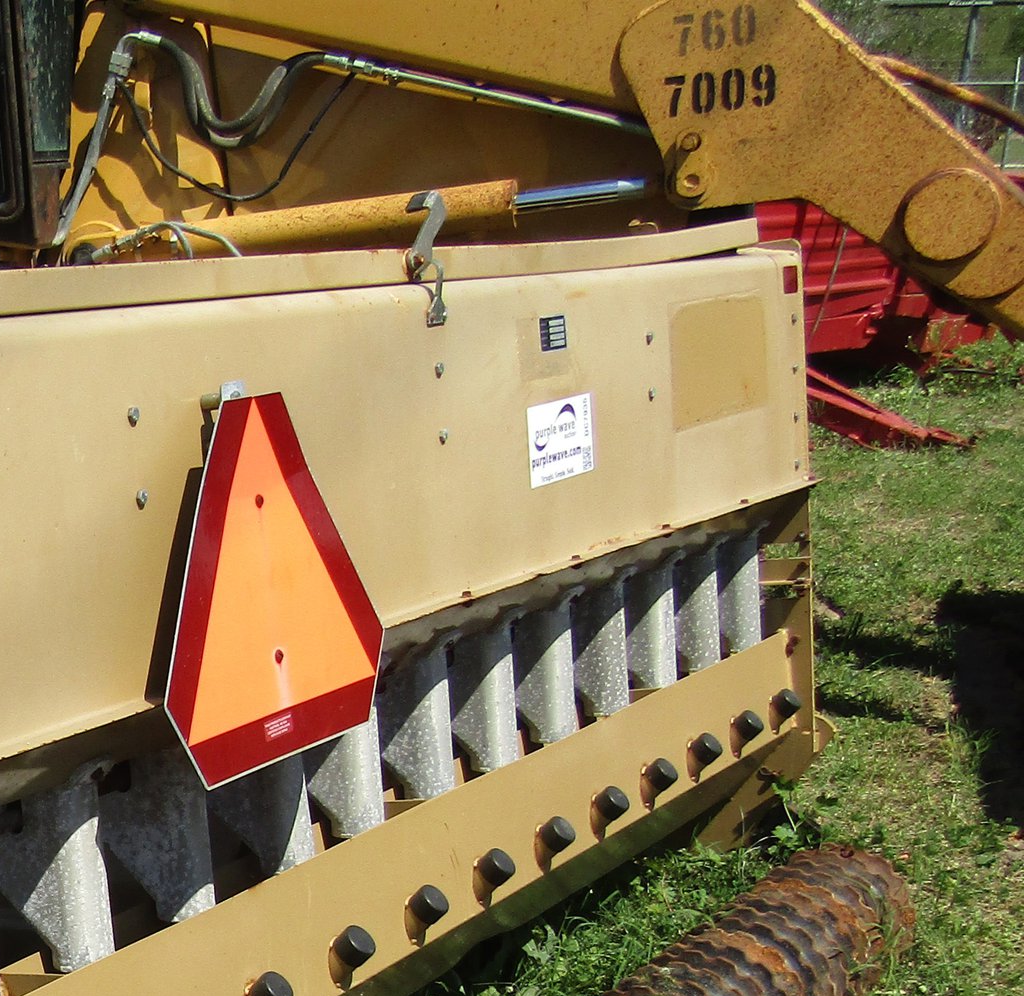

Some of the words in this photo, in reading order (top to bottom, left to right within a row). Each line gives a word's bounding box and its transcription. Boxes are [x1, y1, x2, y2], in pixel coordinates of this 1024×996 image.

[673, 4, 757, 57] 760
[664, 63, 776, 118] 7009
[535, 423, 557, 440] purple
[558, 420, 576, 433] wave
[532, 446, 582, 472] purplewave.com
